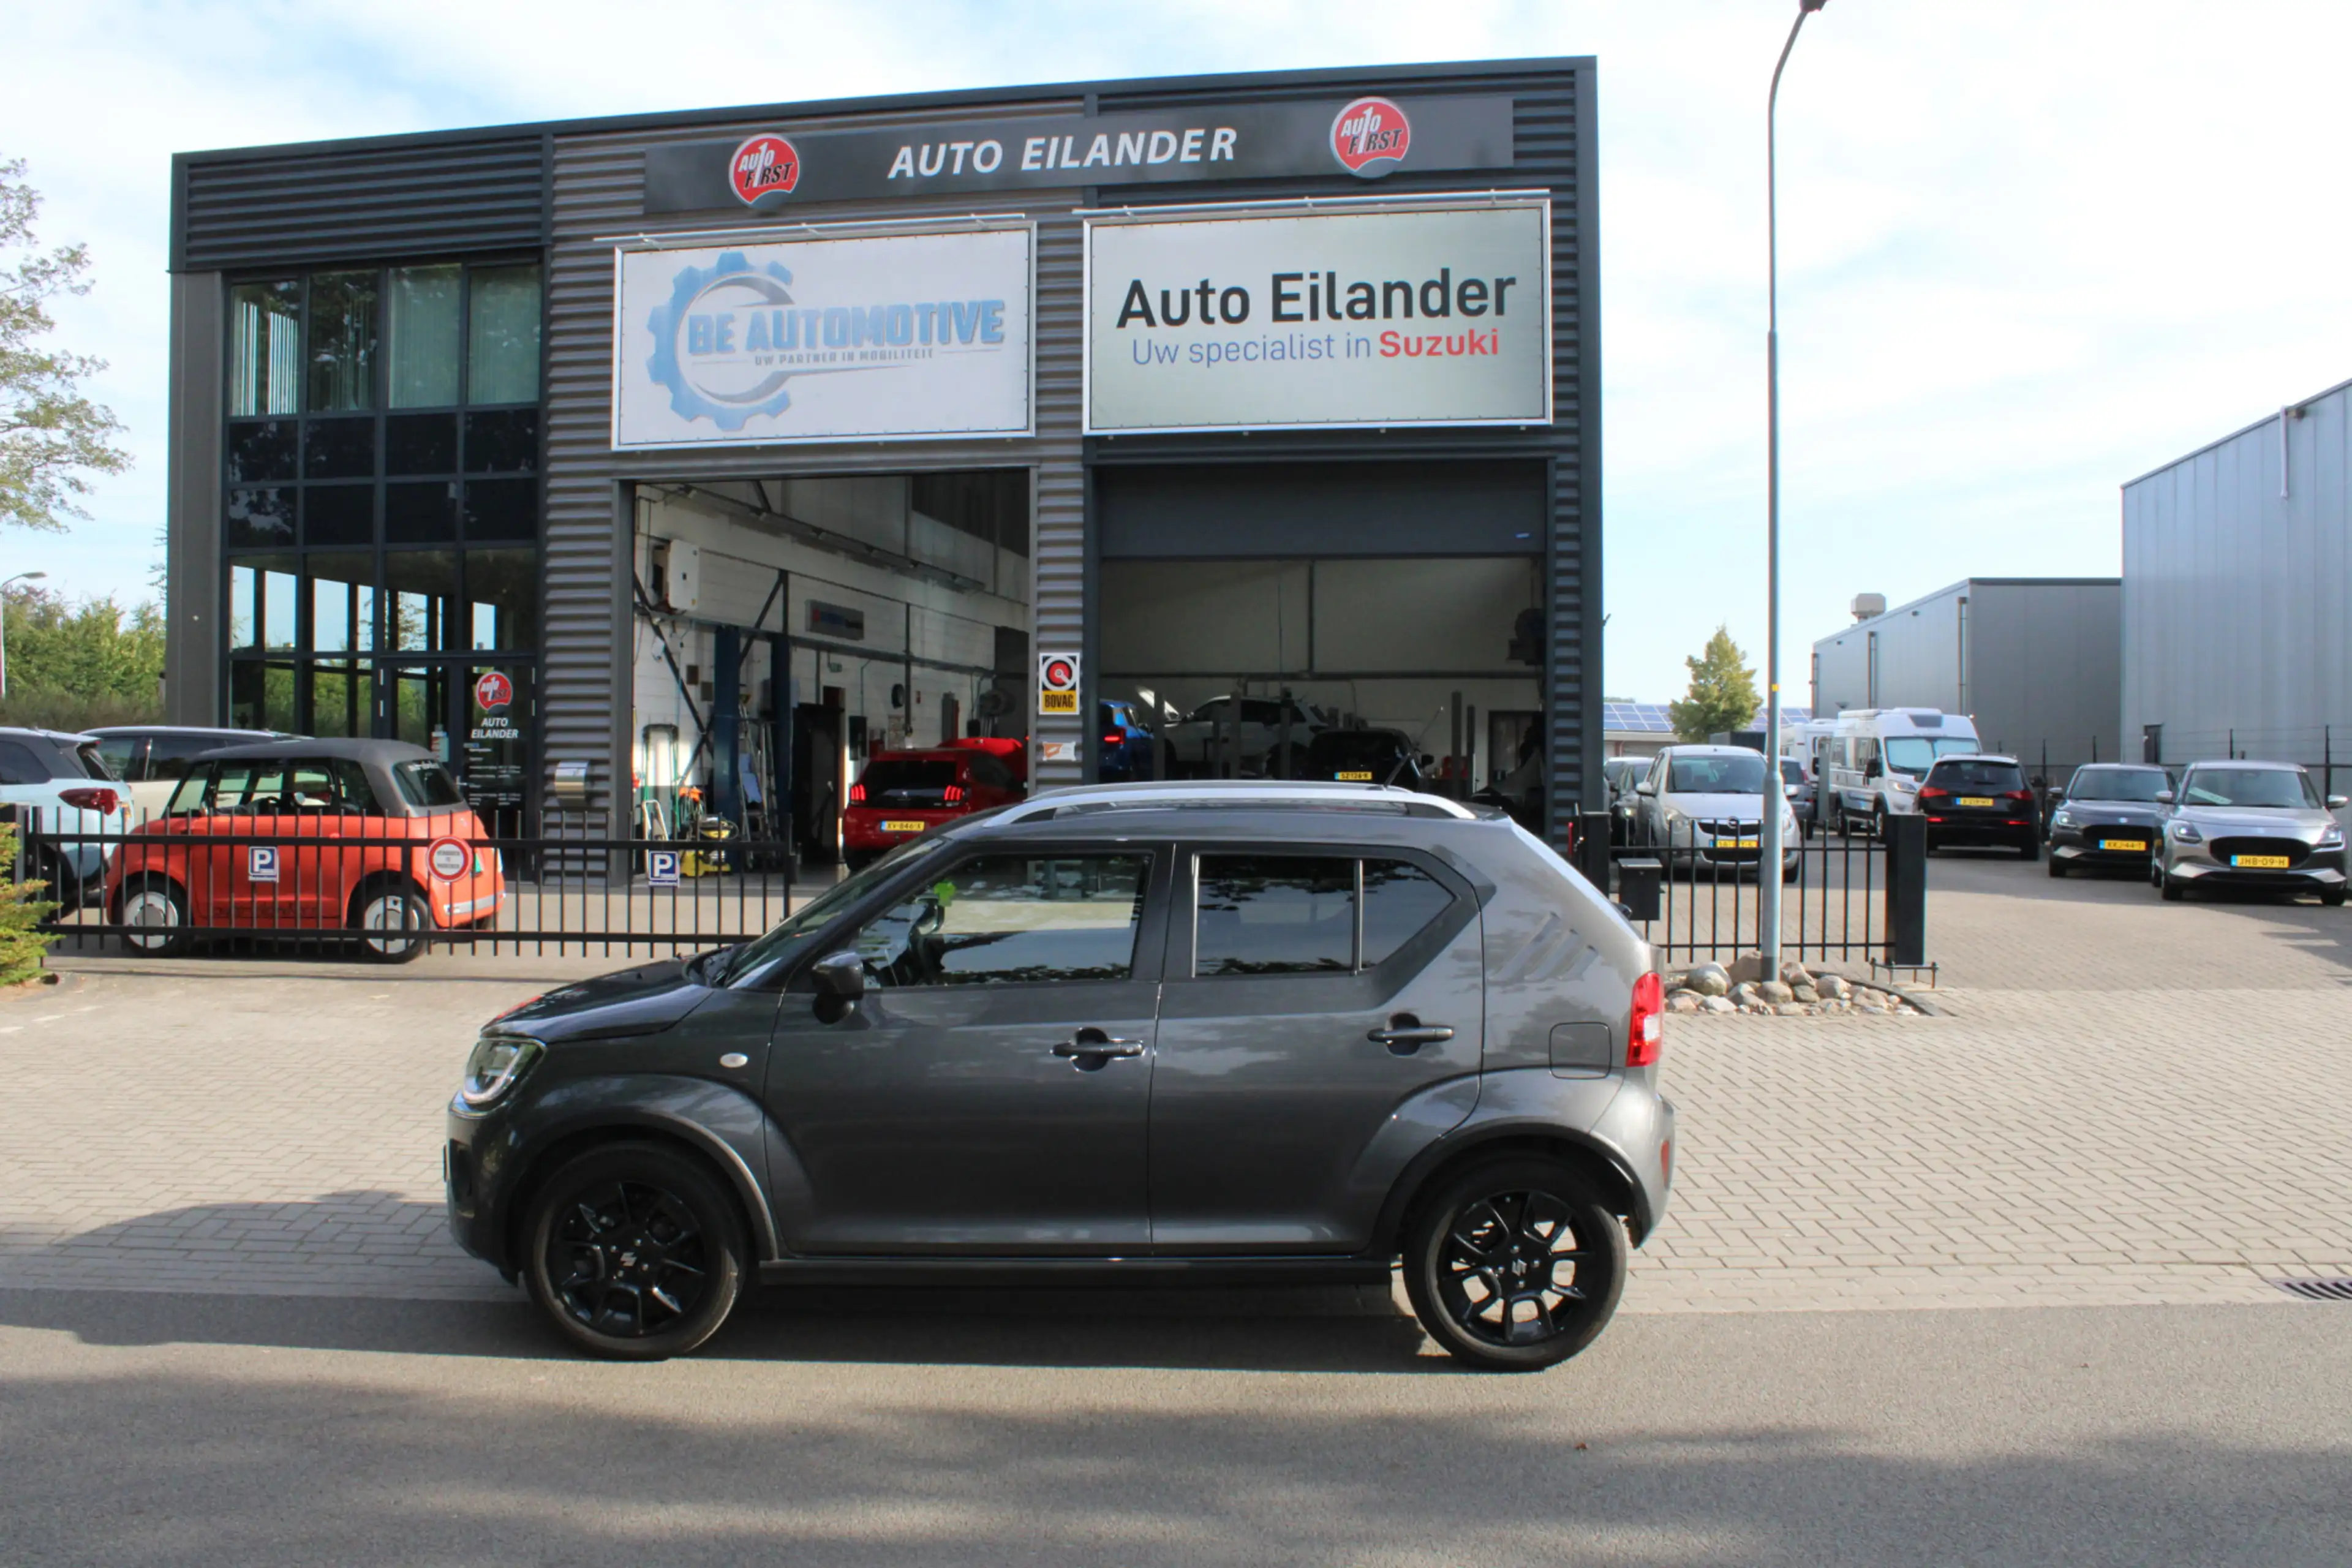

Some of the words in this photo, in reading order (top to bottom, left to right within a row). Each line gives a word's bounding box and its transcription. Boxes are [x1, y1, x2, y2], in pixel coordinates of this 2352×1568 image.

[888, 140, 1003, 179] AUTO
[1021, 127, 1237, 171] EILANDER
[1116, 278, 1251, 329] Auto
[1272, 267, 1517, 323] Eilander
[688, 312, 736, 356] BE
[745, 299, 1006, 352] AUTOMOTIVE
[755, 355, 774, 366] UW
[779, 352, 837, 365] PARTNER
[842, 351, 854, 362] IN
[860, 347, 933, 361] MOBILITEIT
[1133, 338, 1180, 365] Uw
[1189, 333, 1336, 369] specialist
[1346, 331, 1371, 359] in
[1379, 328, 1499, 358] Suzuki
[1044, 694, 1074, 708] BOVAG
[481, 717, 508, 727] AUTO
[470, 728, 519, 739] EILANDER
[254, 850, 272, 872] P
[653, 854, 674, 877] P
